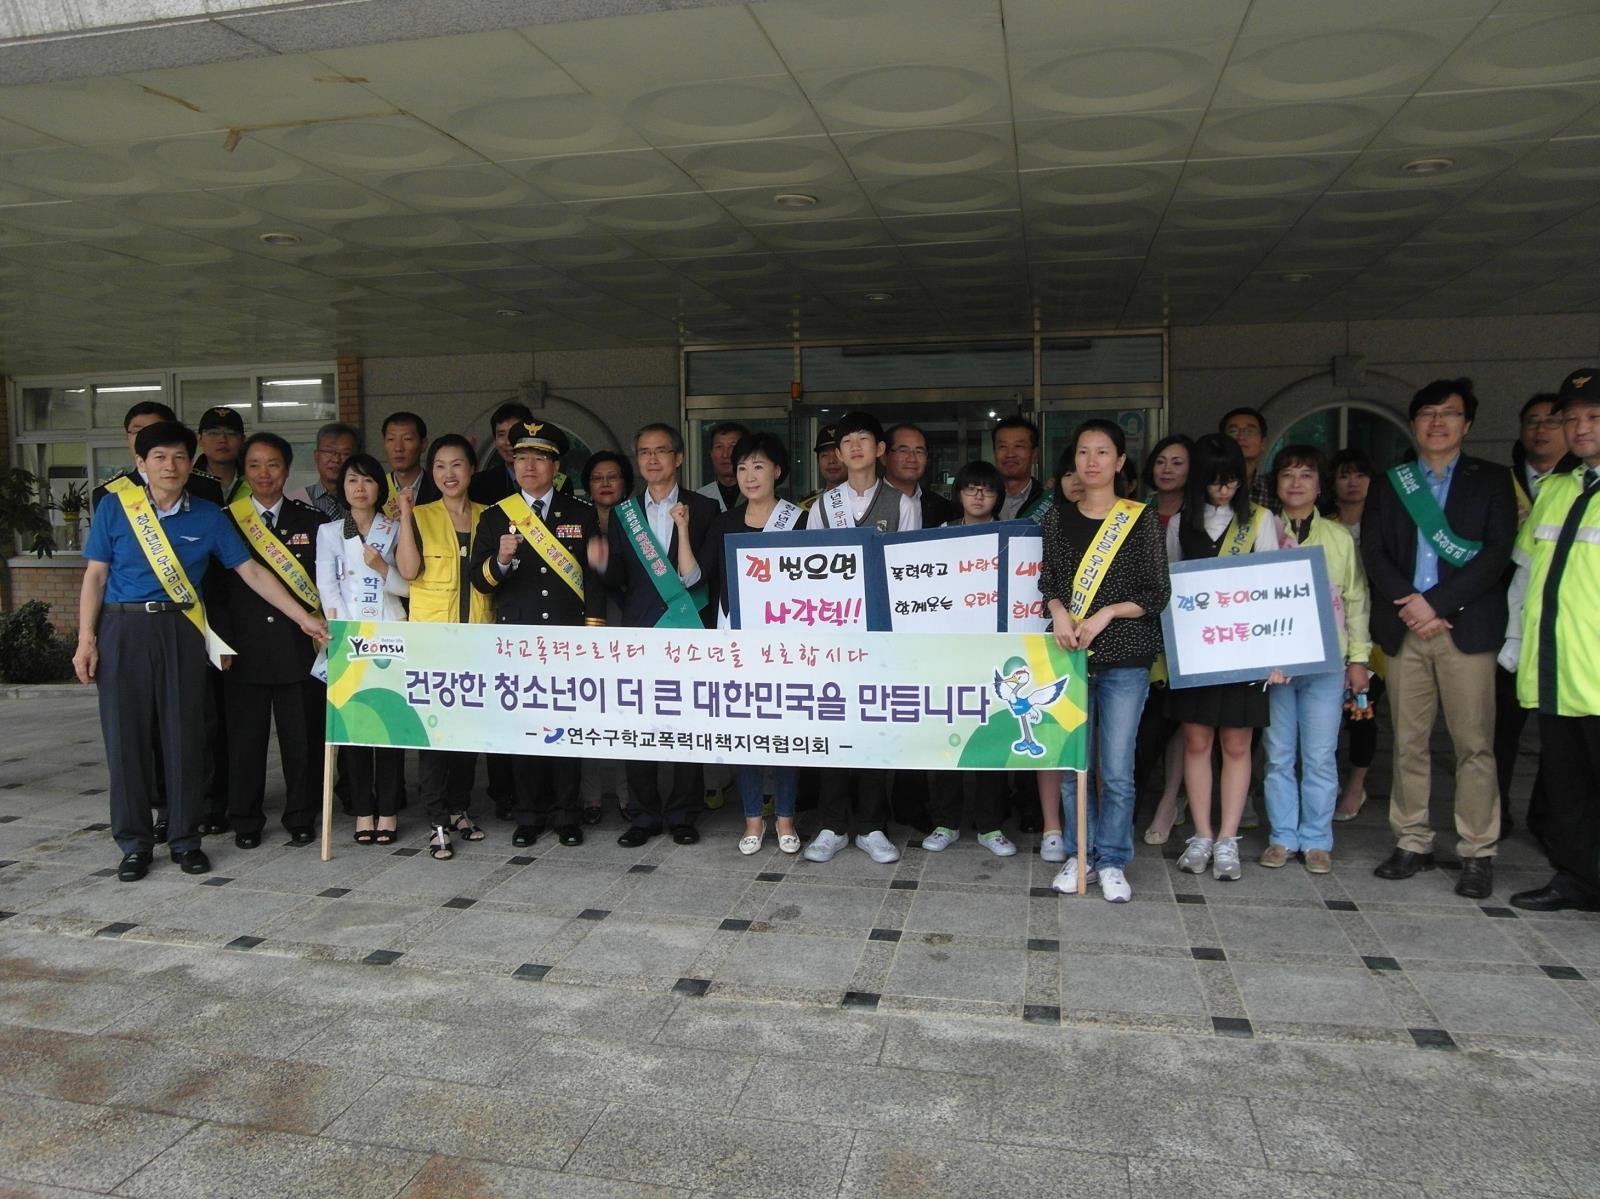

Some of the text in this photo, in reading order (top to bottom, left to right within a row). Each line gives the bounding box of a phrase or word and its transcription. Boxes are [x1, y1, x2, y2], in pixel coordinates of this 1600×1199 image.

[746, 552, 857, 582] 껌 씹으면
[890, 562, 949, 581] 폭력말고
[1070, 511, 1130, 616] 청소년은 우리의 미래
[1215, 589, 1268, 609] 종이에
[1274, 583, 1310, 600] 싸서
[765, 597, 862, 626] 사각턱!!
[1202, 617, 1294, 645] 휴지통에!!!
[350, 638, 404, 656] Yeonsu
[495, 636, 869, 668] 학교폭력으로부터 청소년을 보호합시다
[405, 670, 990, 724] 건강한 청소년이 더 큰 대한민국을 만듭니다
[567, 727, 830, 755] 연수구학교폭력대책지역협의회
